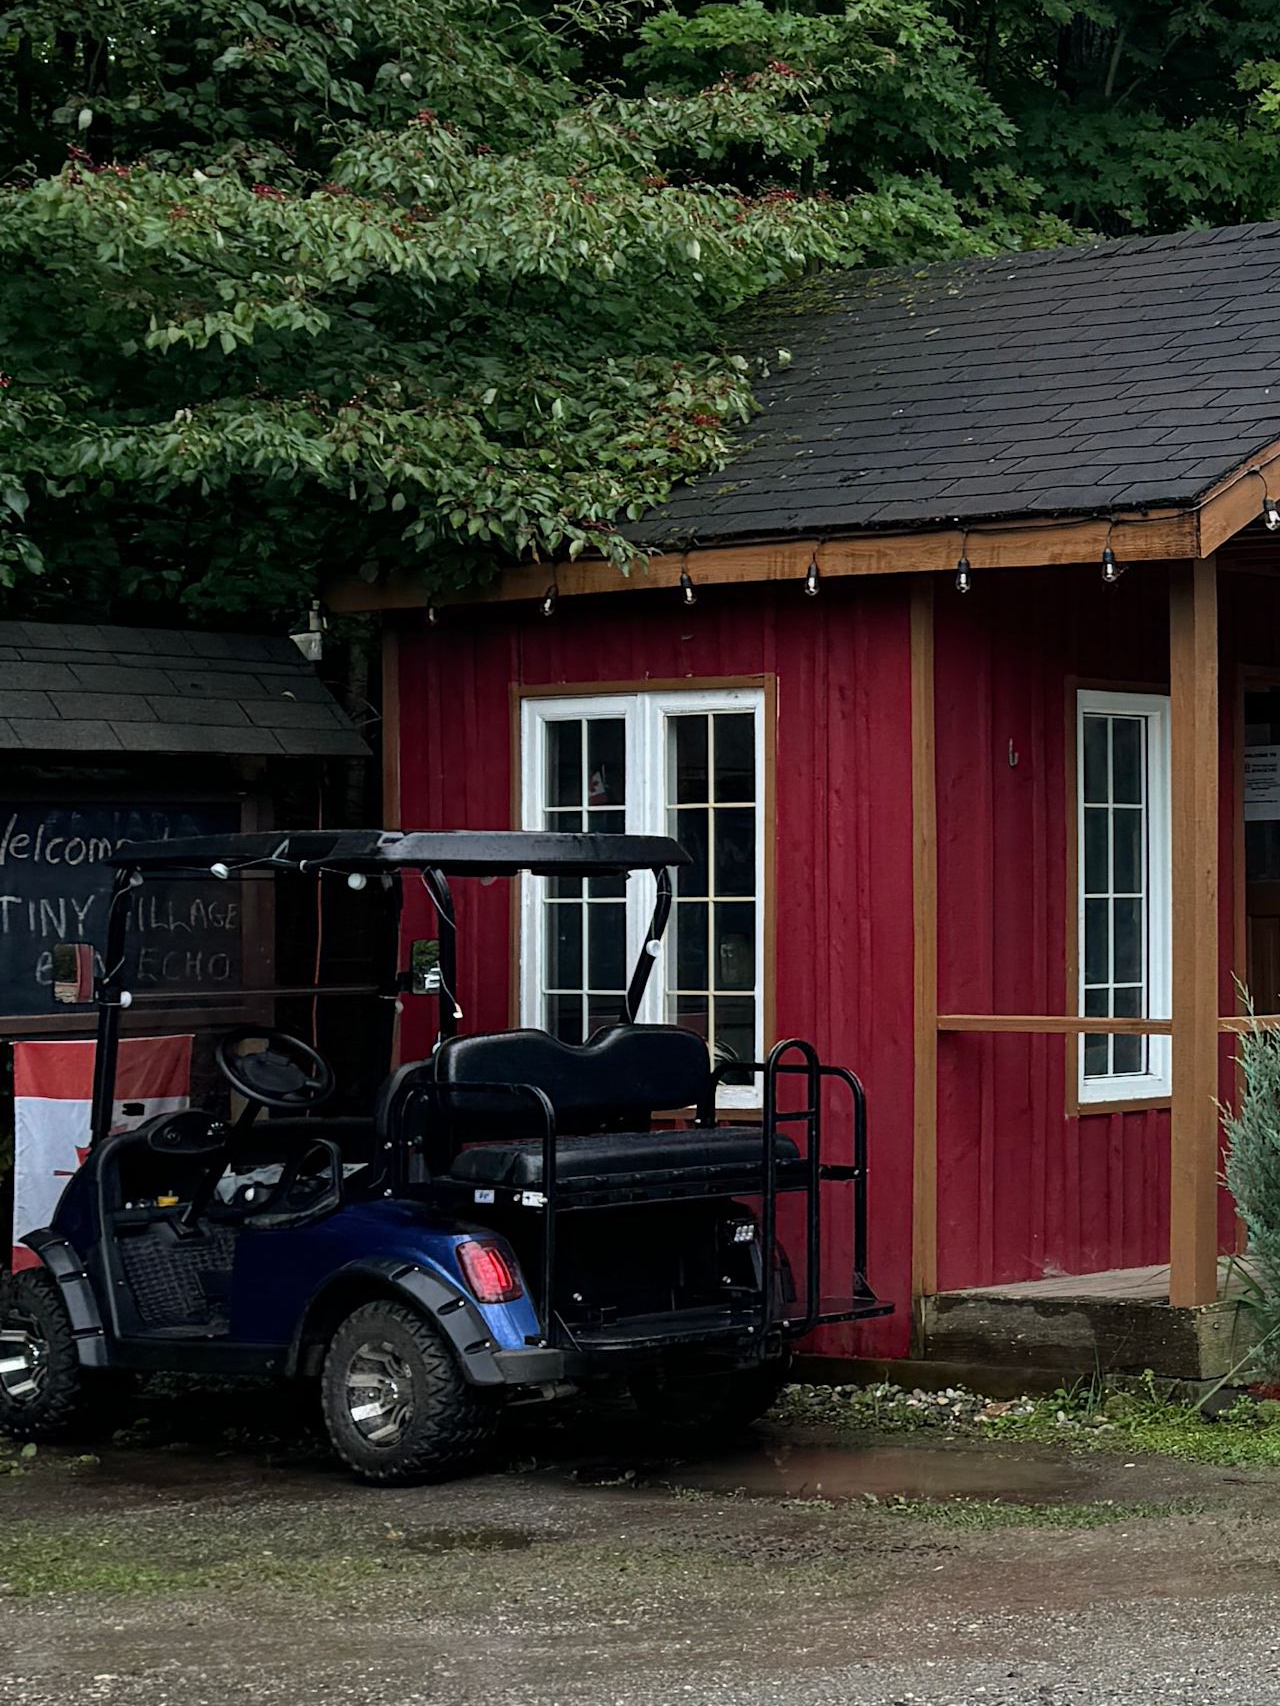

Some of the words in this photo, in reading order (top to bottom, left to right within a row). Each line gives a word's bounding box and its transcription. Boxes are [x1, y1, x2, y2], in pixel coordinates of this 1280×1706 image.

[0, 812, 119, 866] elcom
[0, 894, 96, 939] TINY
[137, 948, 231, 982] ECHO
